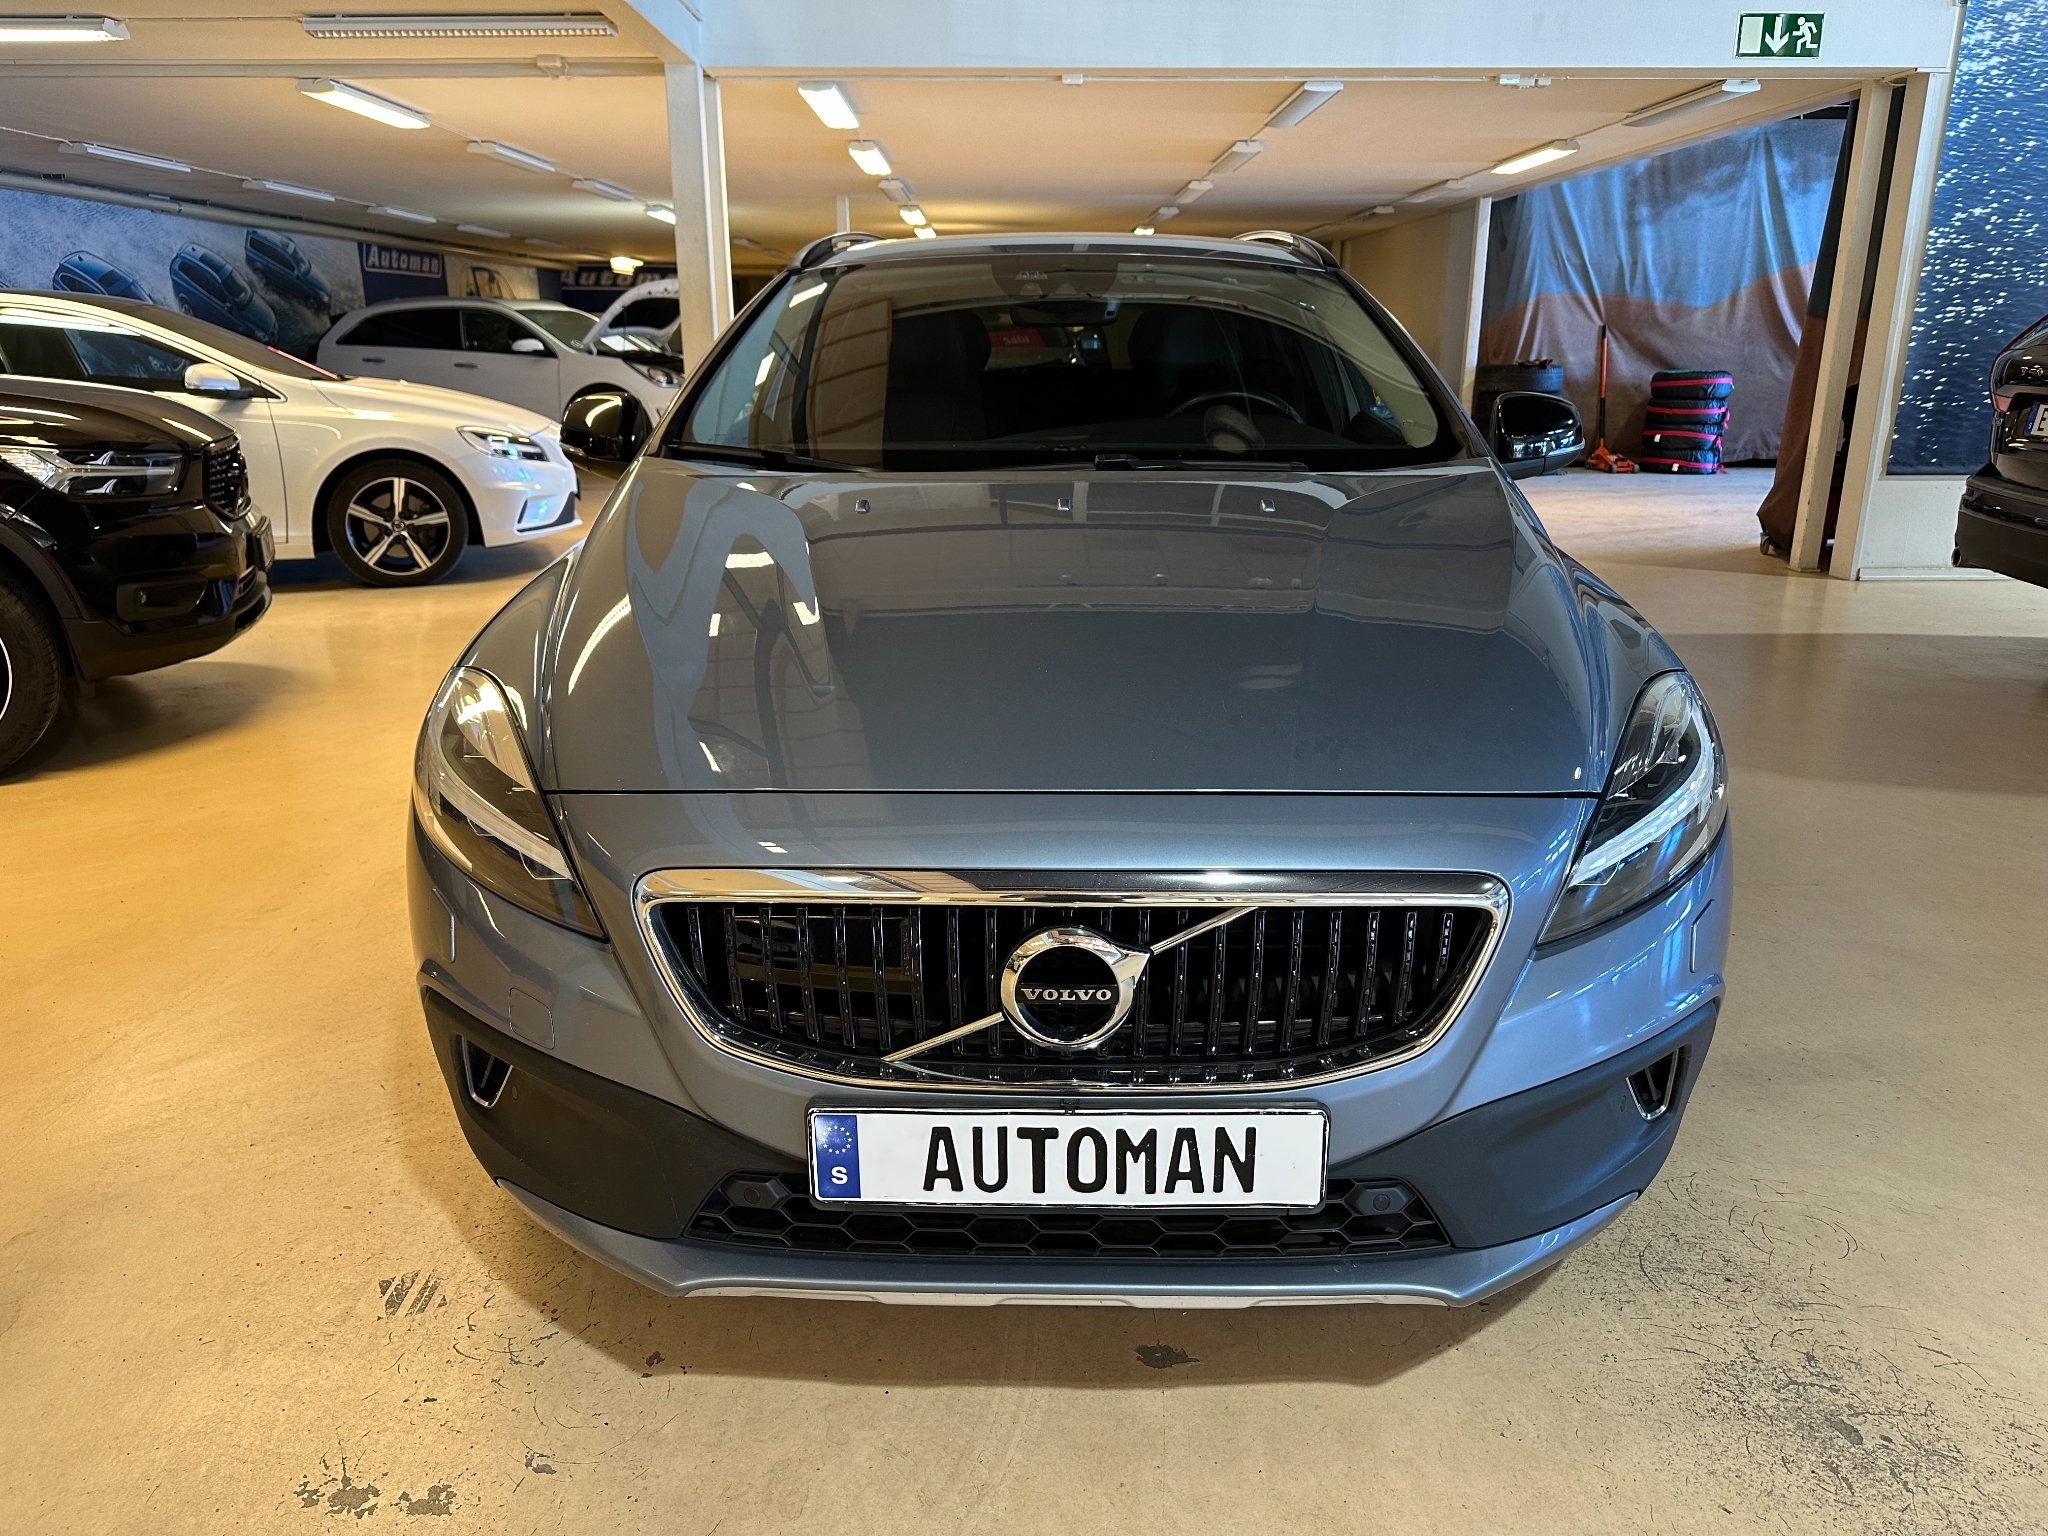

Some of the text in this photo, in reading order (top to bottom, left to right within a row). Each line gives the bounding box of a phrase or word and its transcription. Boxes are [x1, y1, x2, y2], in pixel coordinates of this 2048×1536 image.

[367, 244, 440, 274] Automan
[1021, 988, 1112, 1001] VOLVO
[831, 1126, 1257, 1194] S AUTOMAN
